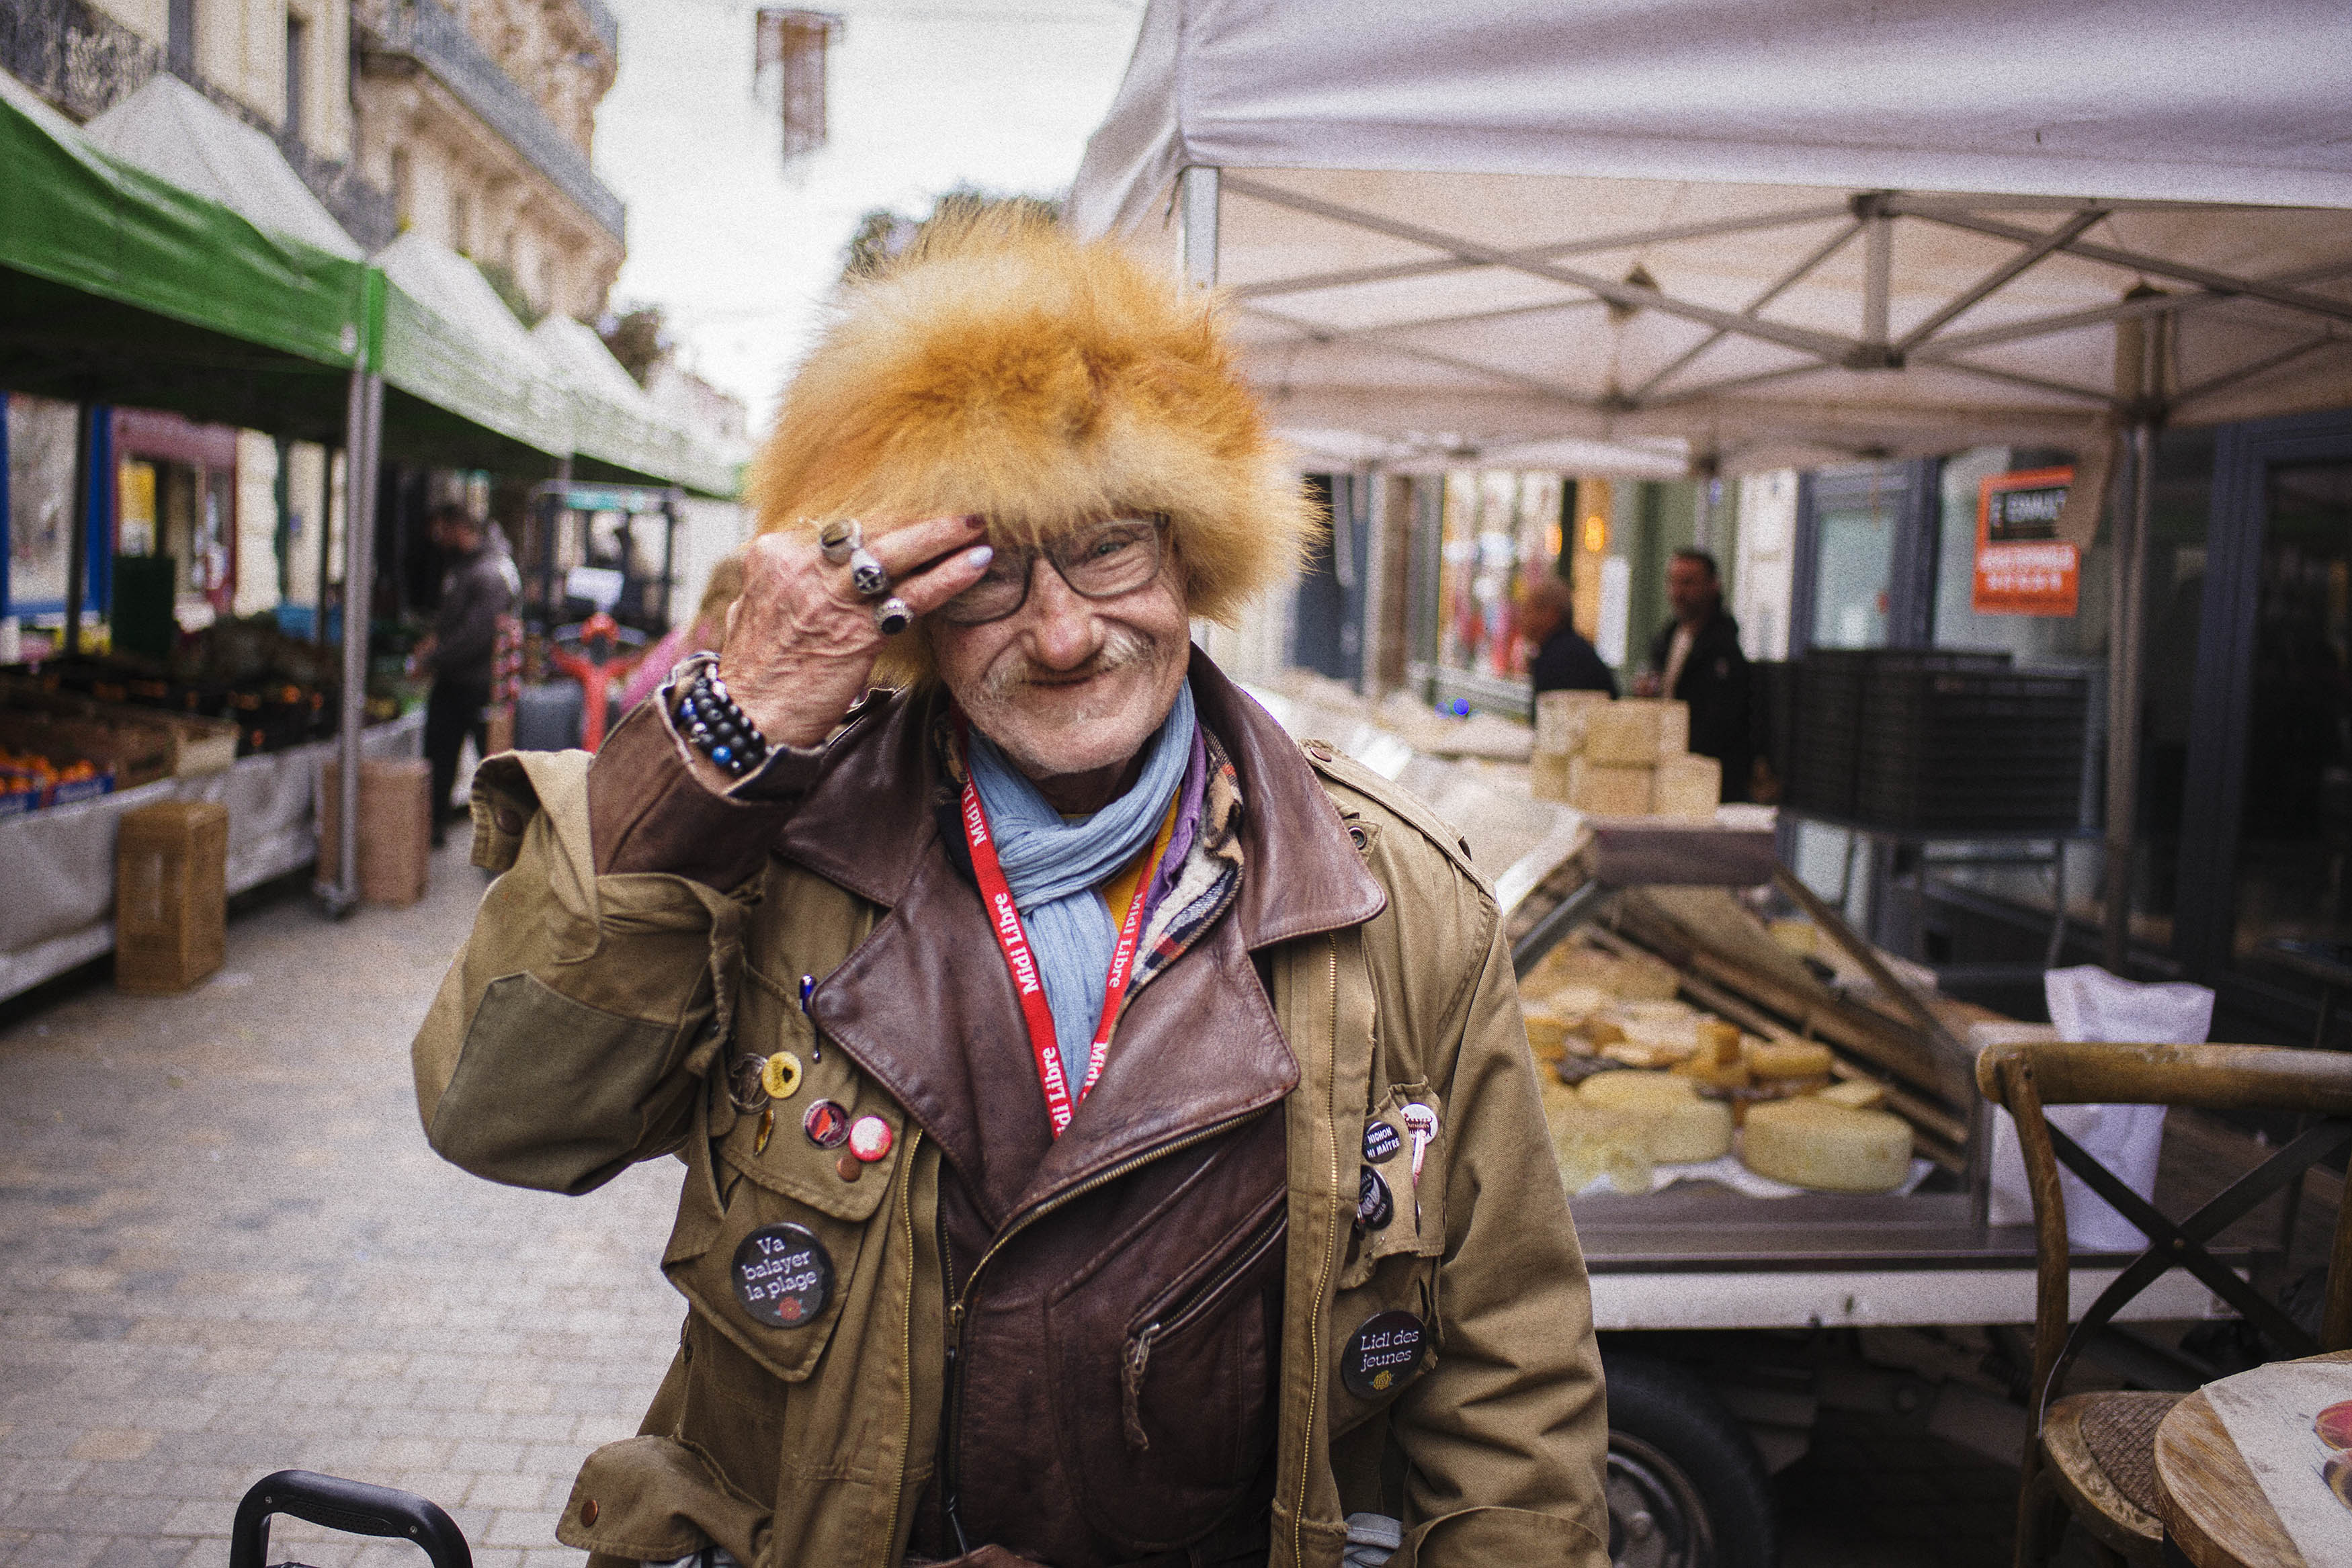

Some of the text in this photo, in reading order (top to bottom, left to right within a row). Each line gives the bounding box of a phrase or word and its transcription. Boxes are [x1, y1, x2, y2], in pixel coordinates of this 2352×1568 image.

[966, 801, 987, 847] Midi
[994, 892, 1040, 995] Midi Libre
[1109, 892, 1143, 988] Midi Libre
[1042, 1046, 1072, 1133] idi Libre
[1366, 1148, 1376, 1158] NI
[756, 1237, 786, 1255] Va
[741, 1251, 810, 1280] balayer
[745, 1271, 818, 1301] la plage
[1360, 1330, 1419, 1351] Lidl des
[1360, 1350, 1413, 1373] jeunes
